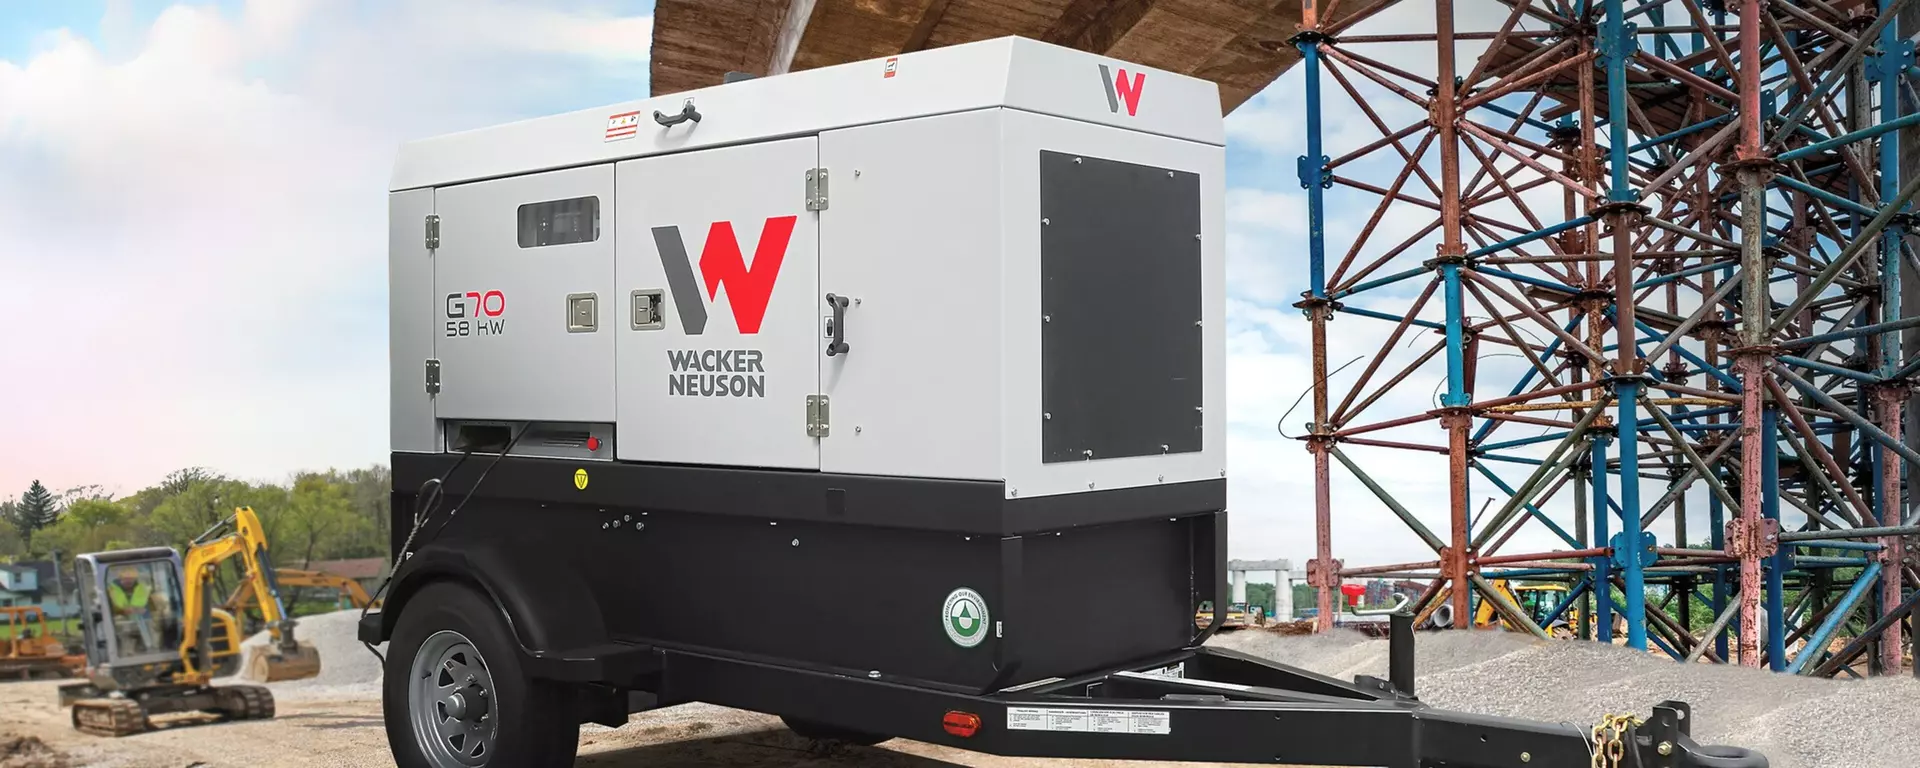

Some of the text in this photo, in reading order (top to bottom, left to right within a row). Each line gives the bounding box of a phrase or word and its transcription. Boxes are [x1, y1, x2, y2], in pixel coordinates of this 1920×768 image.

[1098, 64, 1146, 116] W
[651, 215, 797, 335] W
[446, 290, 505, 318] G70
[446, 321, 469, 337] 58
[667, 349, 765, 373] WACKER
[669, 374, 765, 398] NEUSON
